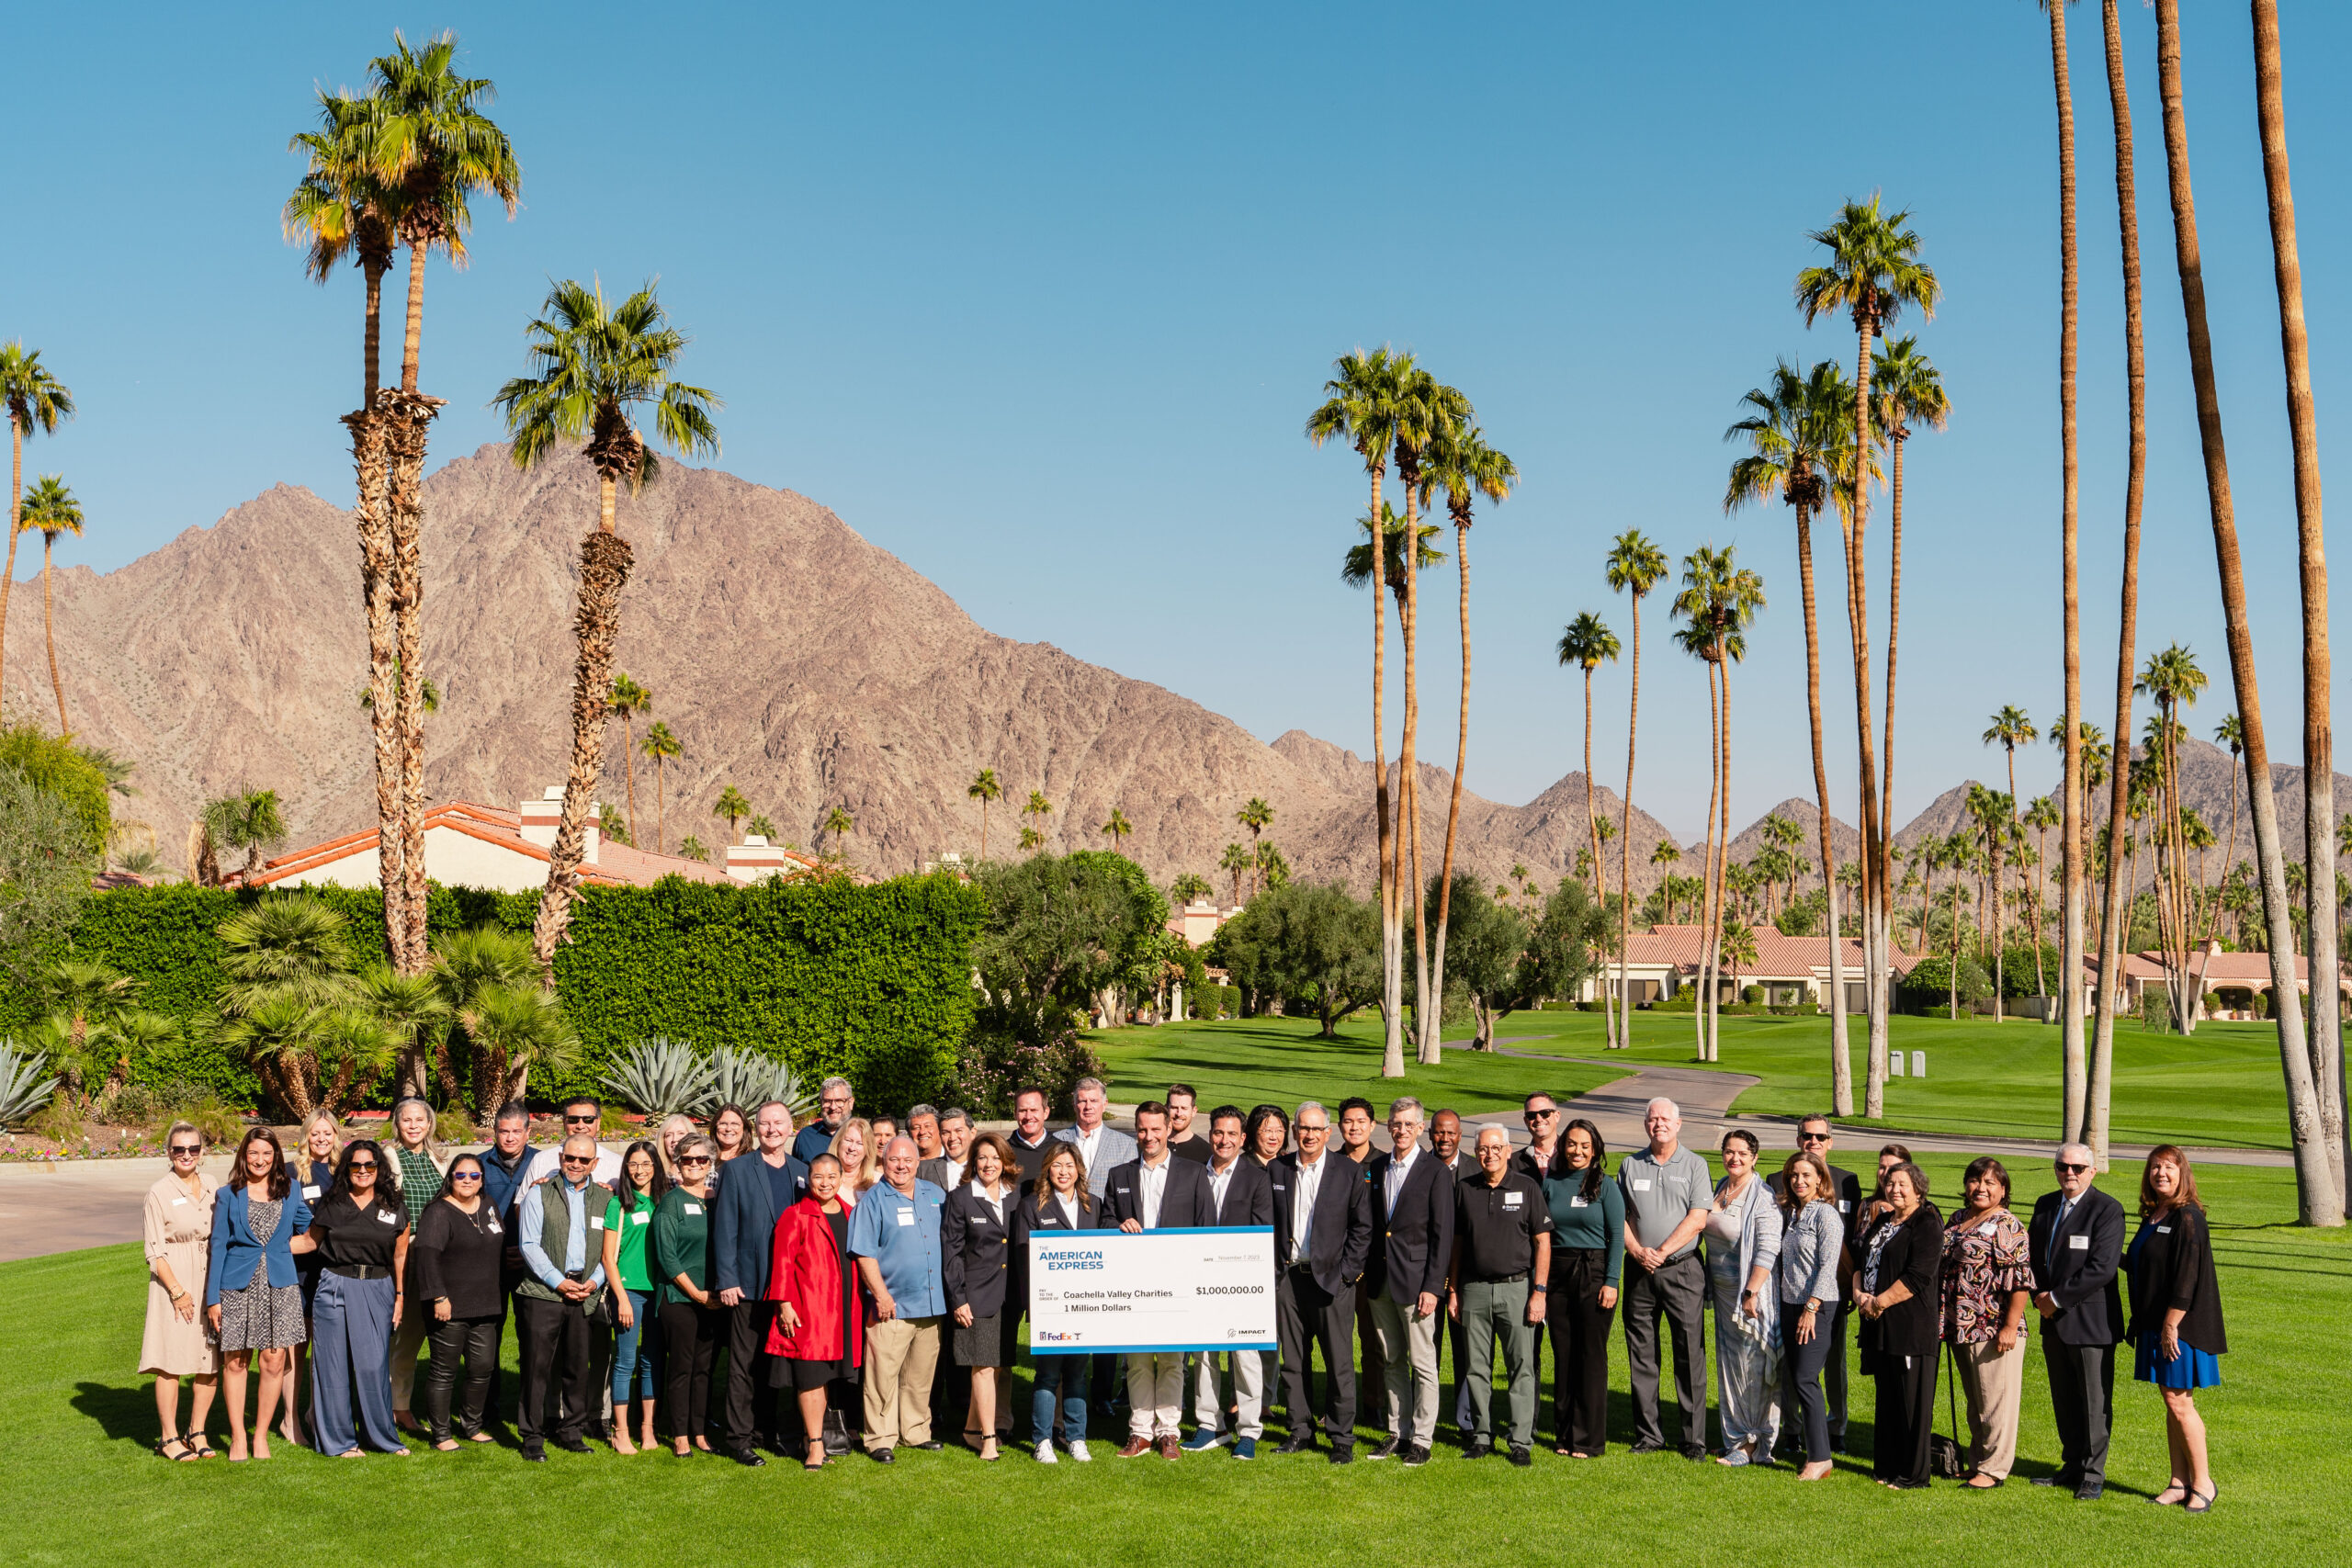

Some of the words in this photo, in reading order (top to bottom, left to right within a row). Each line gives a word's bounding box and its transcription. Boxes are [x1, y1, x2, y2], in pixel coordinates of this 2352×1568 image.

[1039, 1251, 1102, 1260] AMERICAN
[1048, 1261, 1103, 1270] EXPRESS
[1063, 1291, 1104, 1299] Coachella
[1107, 1290, 1132, 1299] Valley
[1134, 1290, 1173, 1298] Charities
[1196, 1286, 1264, 1295] $1,000,000.00
[1102, 1303, 1132, 1312] Dollars
[1047, 1332, 1072, 1341] FedEx
